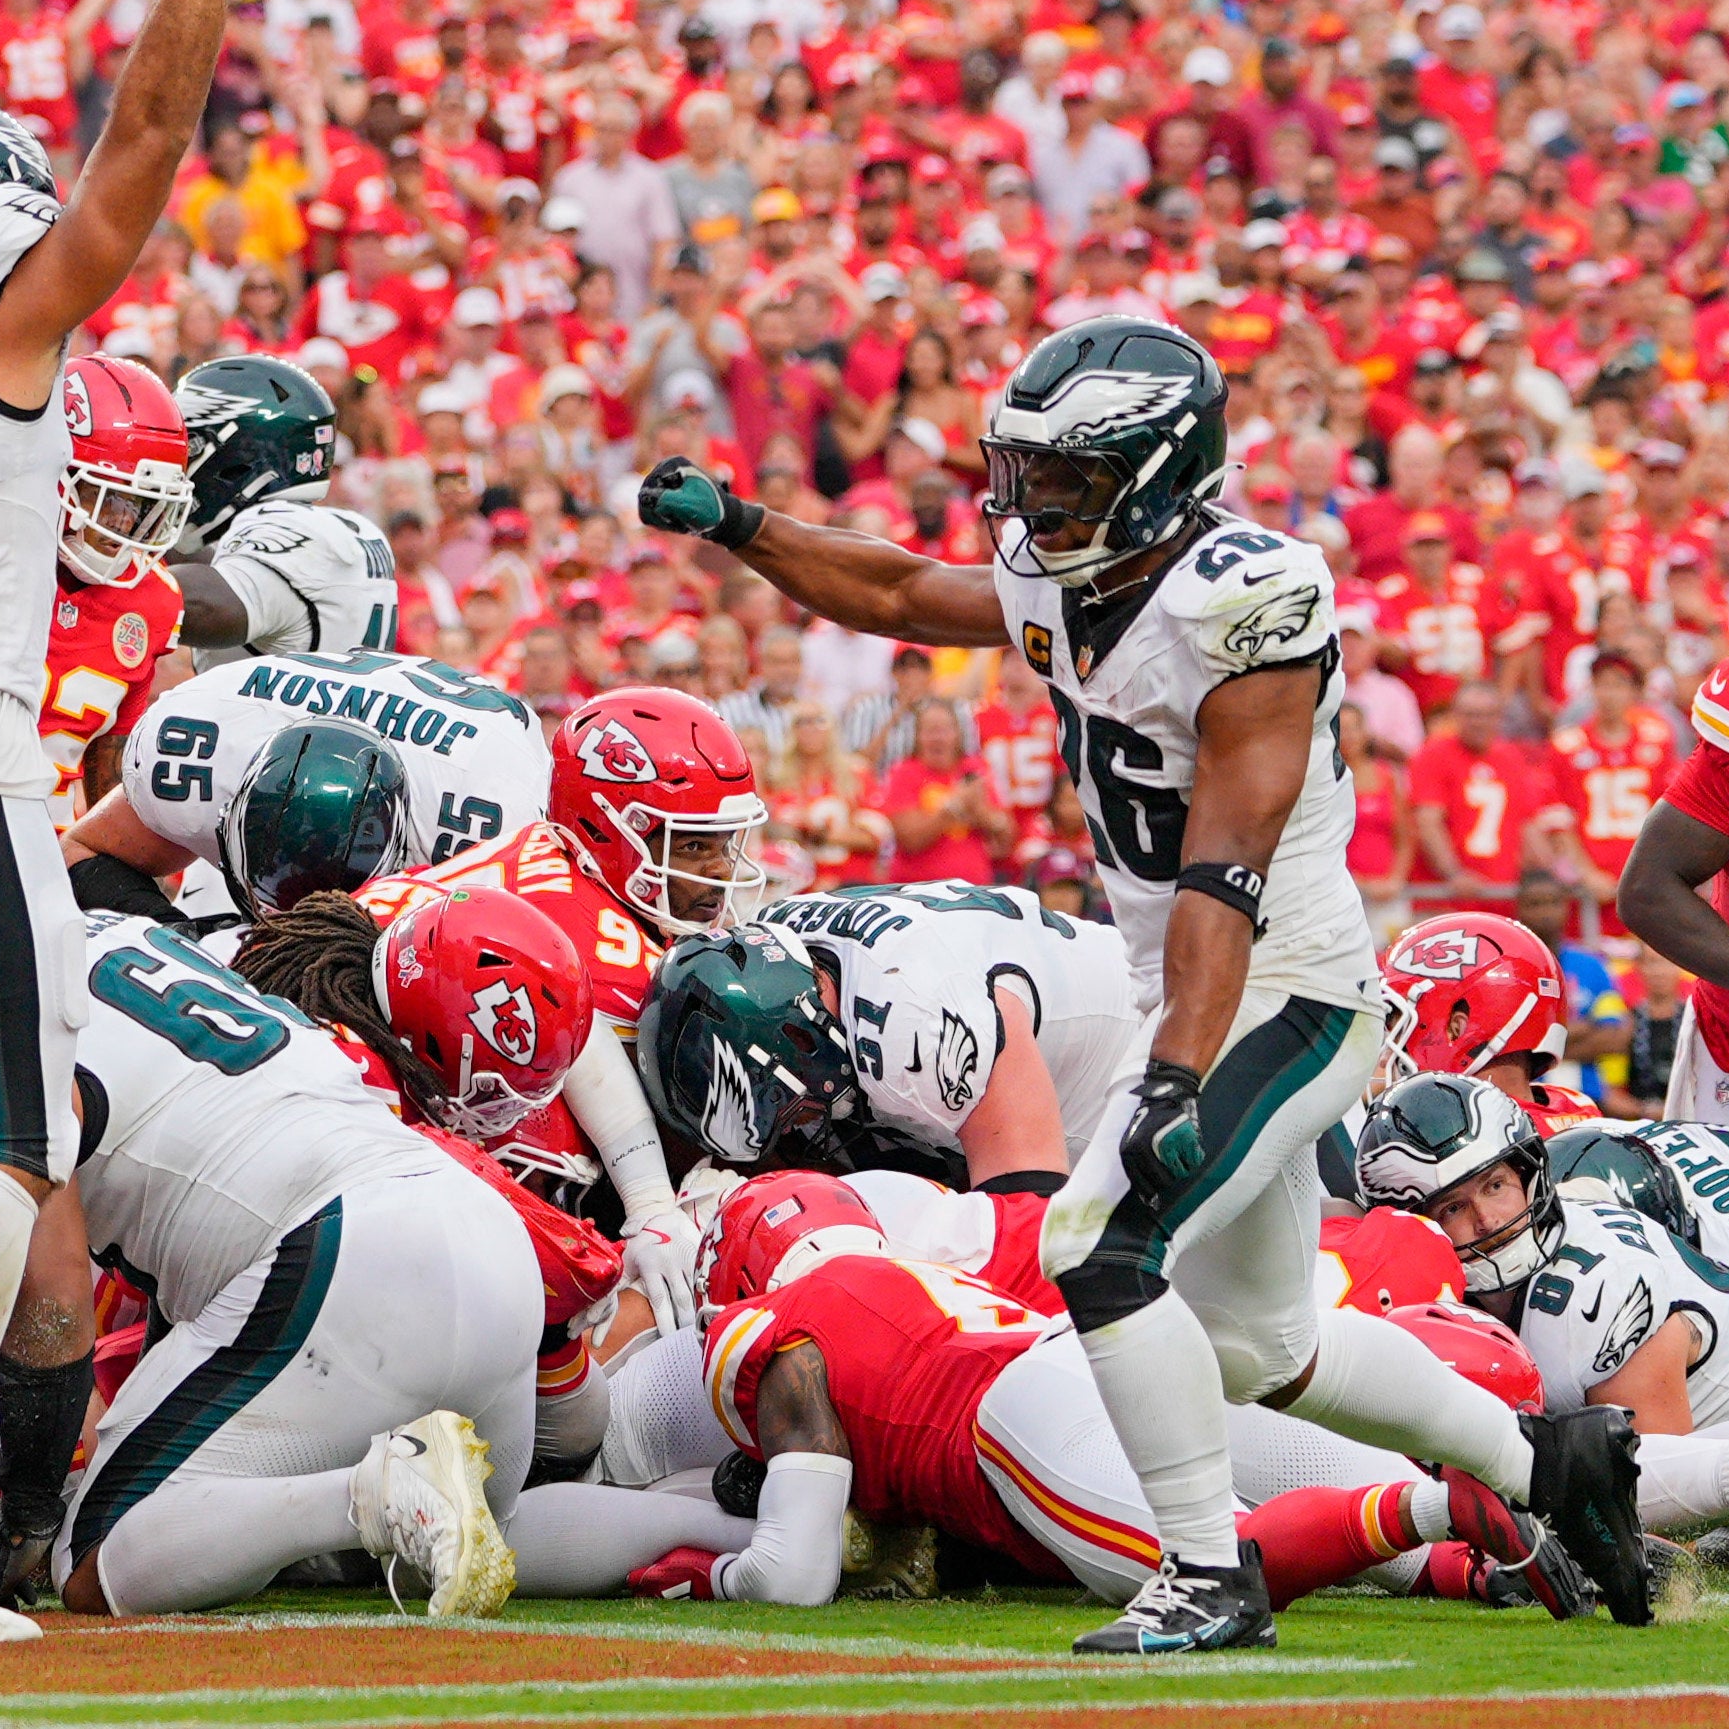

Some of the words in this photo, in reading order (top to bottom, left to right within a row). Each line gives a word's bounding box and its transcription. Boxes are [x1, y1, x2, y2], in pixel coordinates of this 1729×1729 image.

[1024, 625, 1050, 664] C
[237, 663, 478, 757] JOHNSON
[151, 715, 221, 803] 65
[594, 730, 647, 780] KC
[984, 736, 1054, 809] 15
[1464, 779, 1508, 857] 7
[1584, 766, 1652, 840] 15
[756, 897, 913, 949] JURGEN
[1410, 939, 1465, 970] KC
[491, 995, 533, 1059] KC
[1528, 1242, 1607, 1317] 81
